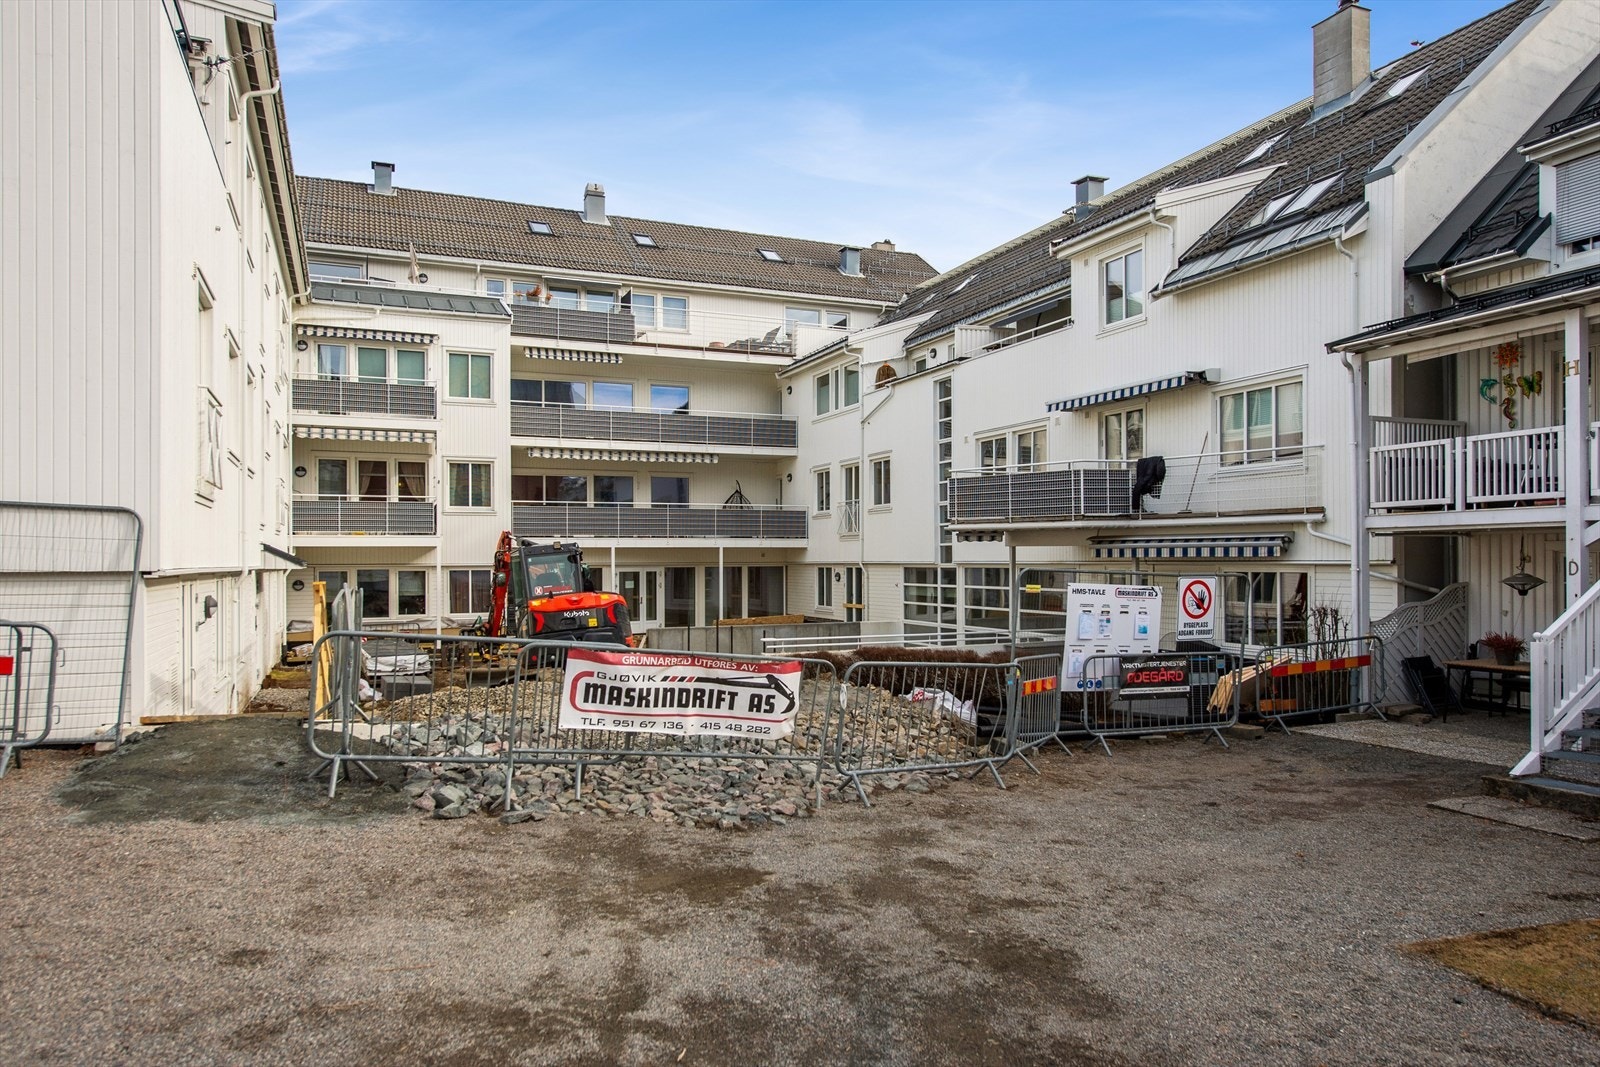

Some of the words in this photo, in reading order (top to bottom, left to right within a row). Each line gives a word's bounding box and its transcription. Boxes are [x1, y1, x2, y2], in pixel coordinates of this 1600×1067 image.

[1564, 360, 1580, 377] H
[1568, 561, 1579, 576] D
[1071, 588, 1106, 596] HMS-TAVLE
[1183, 621, 1209, 629] BYGGEPLASS
[621, 655, 691, 666] GRUNNARBEID
[694, 658, 737, 669] UTFØRES
[740, 663, 759, 672] AV:
[596, 671, 657, 683] GJØVIK
[1127, 667, 1184, 683] ØDEGÅRD
[582, 682, 739, 711] MASKINDRIFT
[748, 693, 776, 714] AS
[581, 717, 606, 726] TLF.
[612, 719, 634, 728] 951
[639, 720, 656, 729] 67
[662, 721, 684, 730] 136
[700, 722, 721, 730] 415
[725, 723, 743, 732] 48
[746, 725, 771, 735] 282
